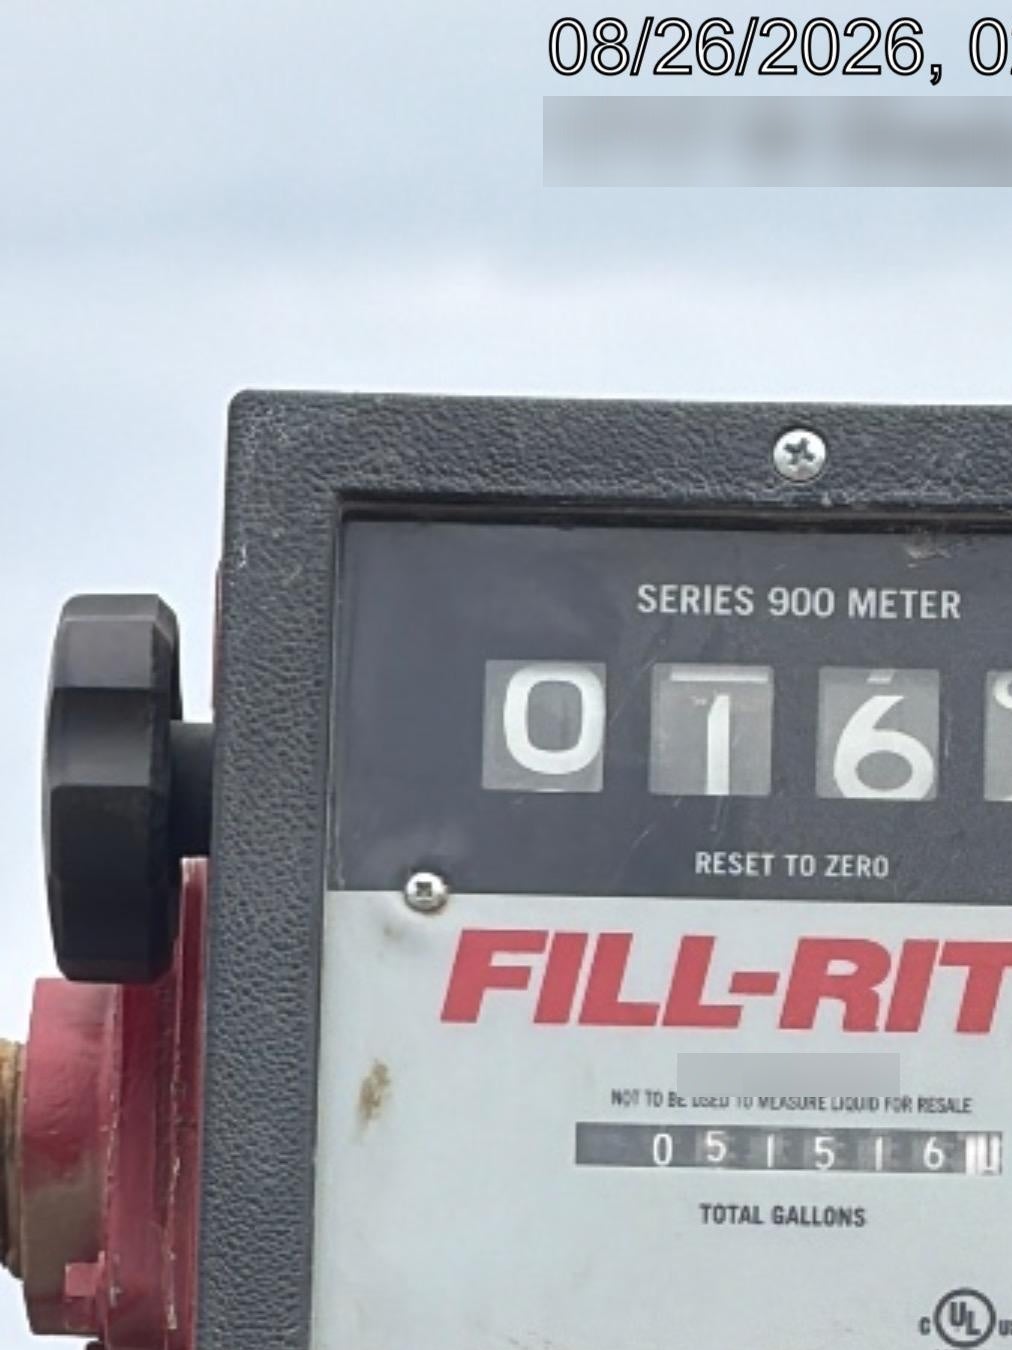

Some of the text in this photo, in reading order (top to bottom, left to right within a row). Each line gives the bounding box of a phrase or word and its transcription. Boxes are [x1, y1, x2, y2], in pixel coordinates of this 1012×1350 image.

[637, 583, 961, 620] SERIES 900 METER
[695, 850, 890, 880] RESET TO ZERO
[611, 1088, 640, 1107] NOT
[644, 1089, 664, 1108] TO
[884, 1095, 913, 1113] FOR
[917, 1096, 974, 1114] RESALE
[700, 1203, 867, 1228] TOTAL GALLONS
[950, 1301, 982, 1336] UL
